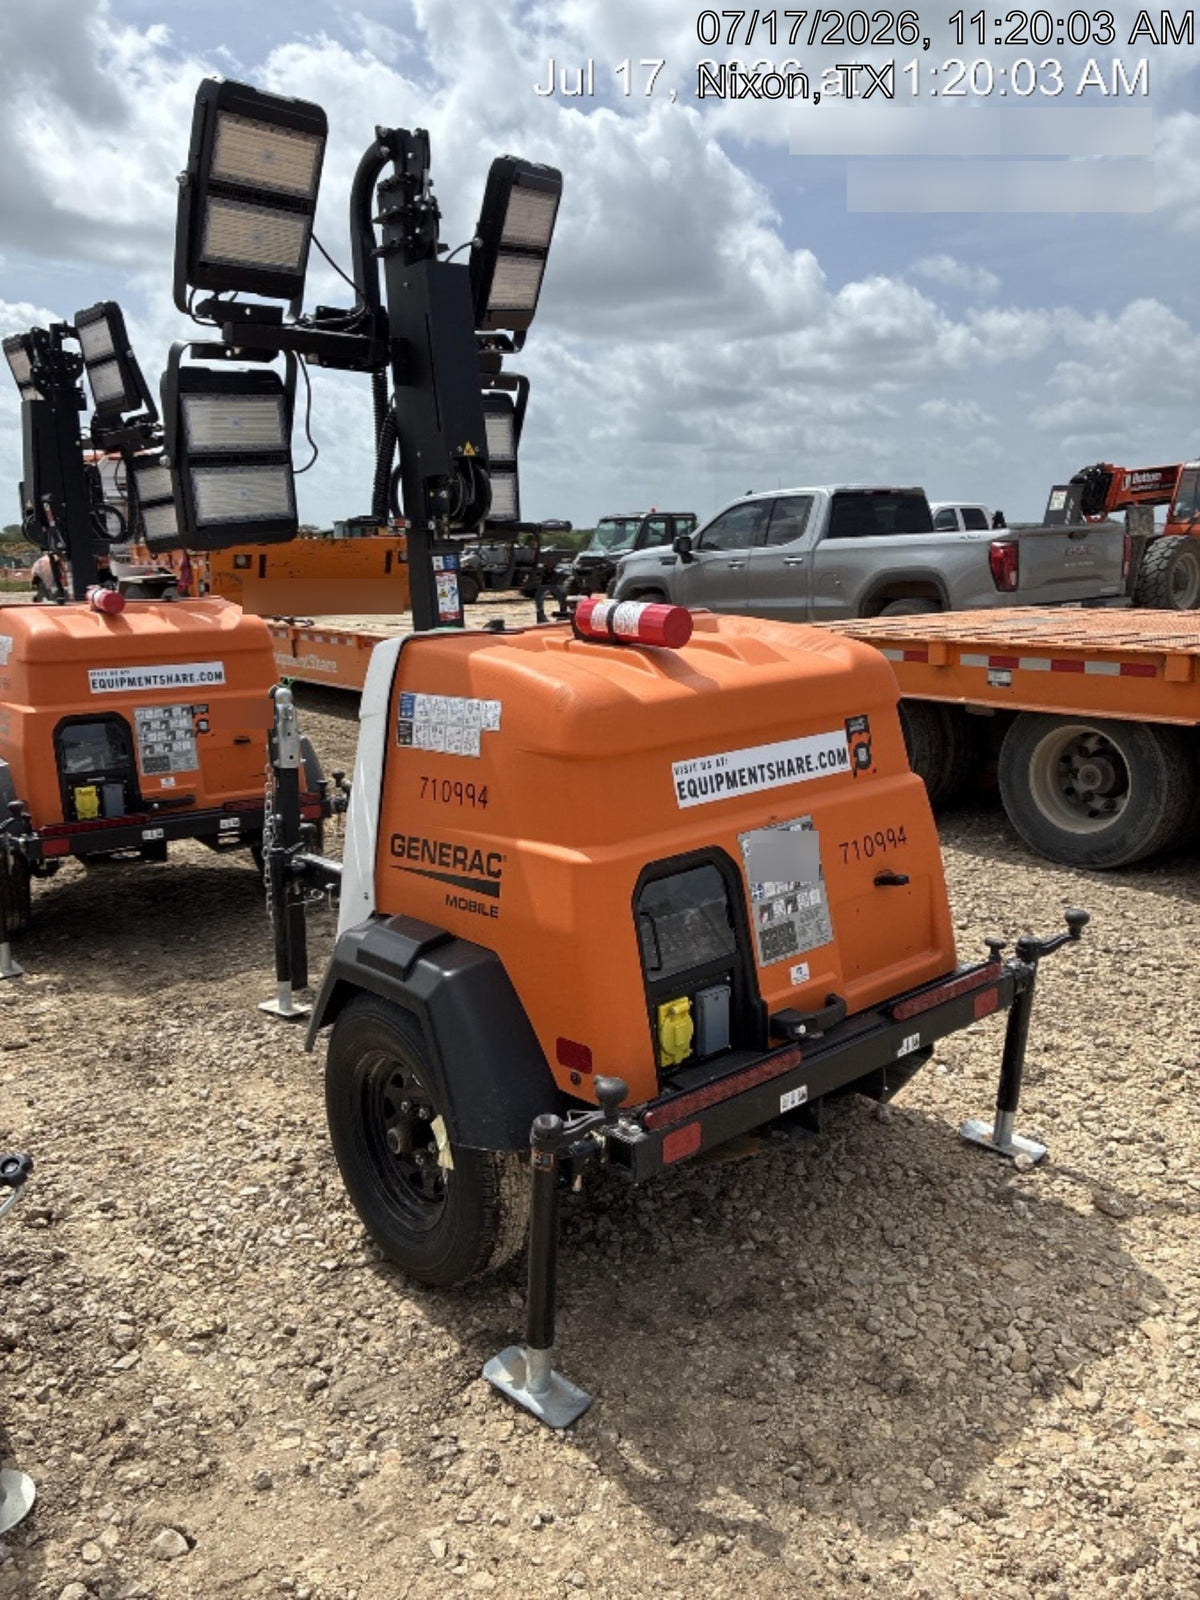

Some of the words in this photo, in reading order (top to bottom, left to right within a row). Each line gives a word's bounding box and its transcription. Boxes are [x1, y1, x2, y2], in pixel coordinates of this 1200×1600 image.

[91, 671, 223, 689] EQUIPMENTSHARE.COM
[677, 747, 849, 801] EQUIPMENTSHARE.COM
[701, 760, 712, 771] US
[420, 776, 488, 808] 710994
[390, 833, 503, 879] GENERAC
[838, 824, 907, 864] 710994
[445, 894, 499, 919] MOBILE
